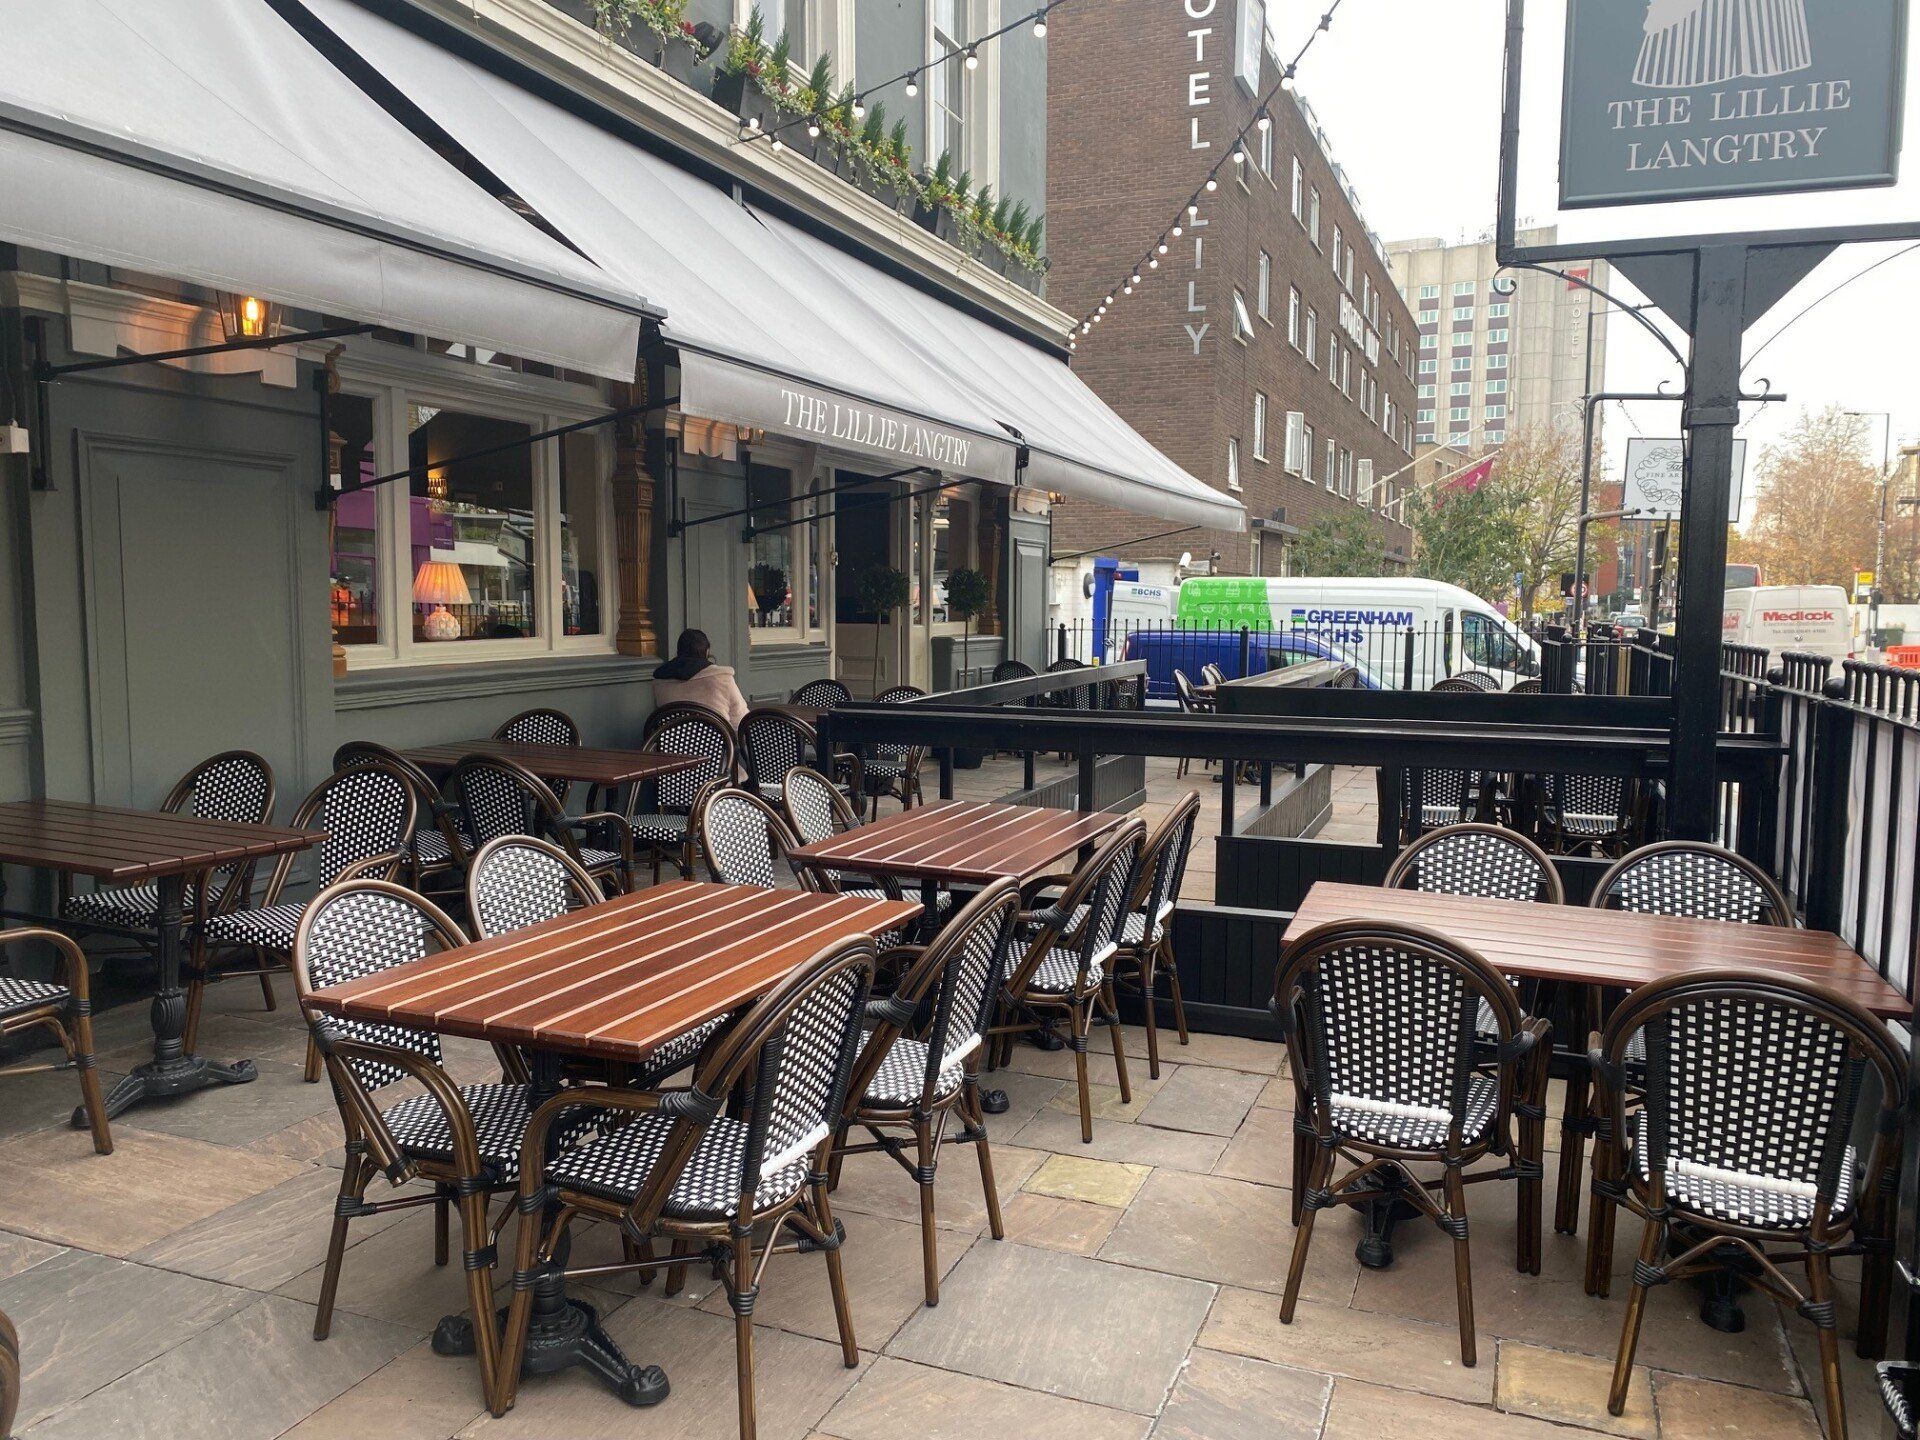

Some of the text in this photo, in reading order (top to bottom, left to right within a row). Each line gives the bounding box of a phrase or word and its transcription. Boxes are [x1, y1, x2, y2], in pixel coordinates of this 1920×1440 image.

[1607, 79, 1851, 130] THE LILLIE
[1626, 127, 1827, 171] LANGTRY
[1184, 197, 1210, 355] LILY
[781, 389, 971, 467] THE LILLIE LANGTRY
[1138, 588, 1161, 597] BCHS
[1307, 609, 1413, 626] GREENHAM
[1763, 611, 1834, 621] Medlock
